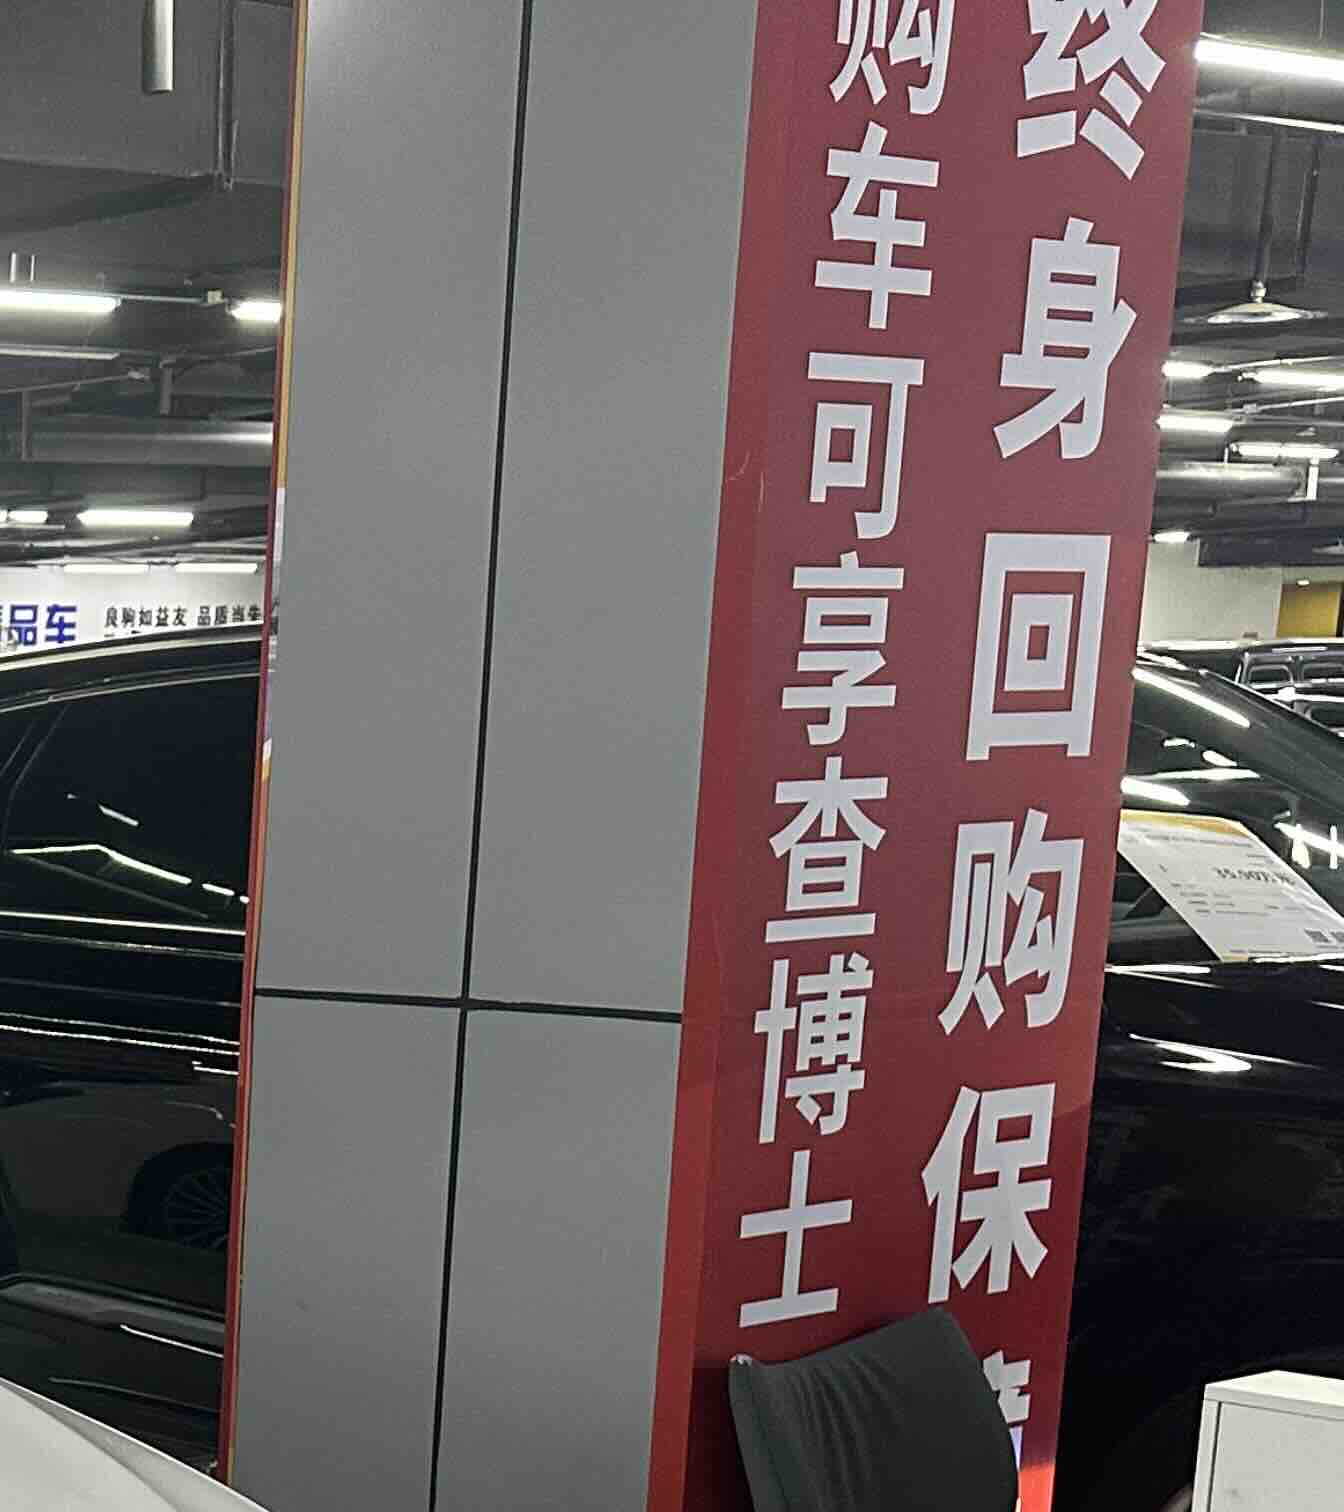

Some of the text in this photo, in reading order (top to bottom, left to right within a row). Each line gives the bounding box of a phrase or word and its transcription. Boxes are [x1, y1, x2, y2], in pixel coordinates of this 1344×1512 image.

[921, 0, 1165, 1474] 终身回购保
